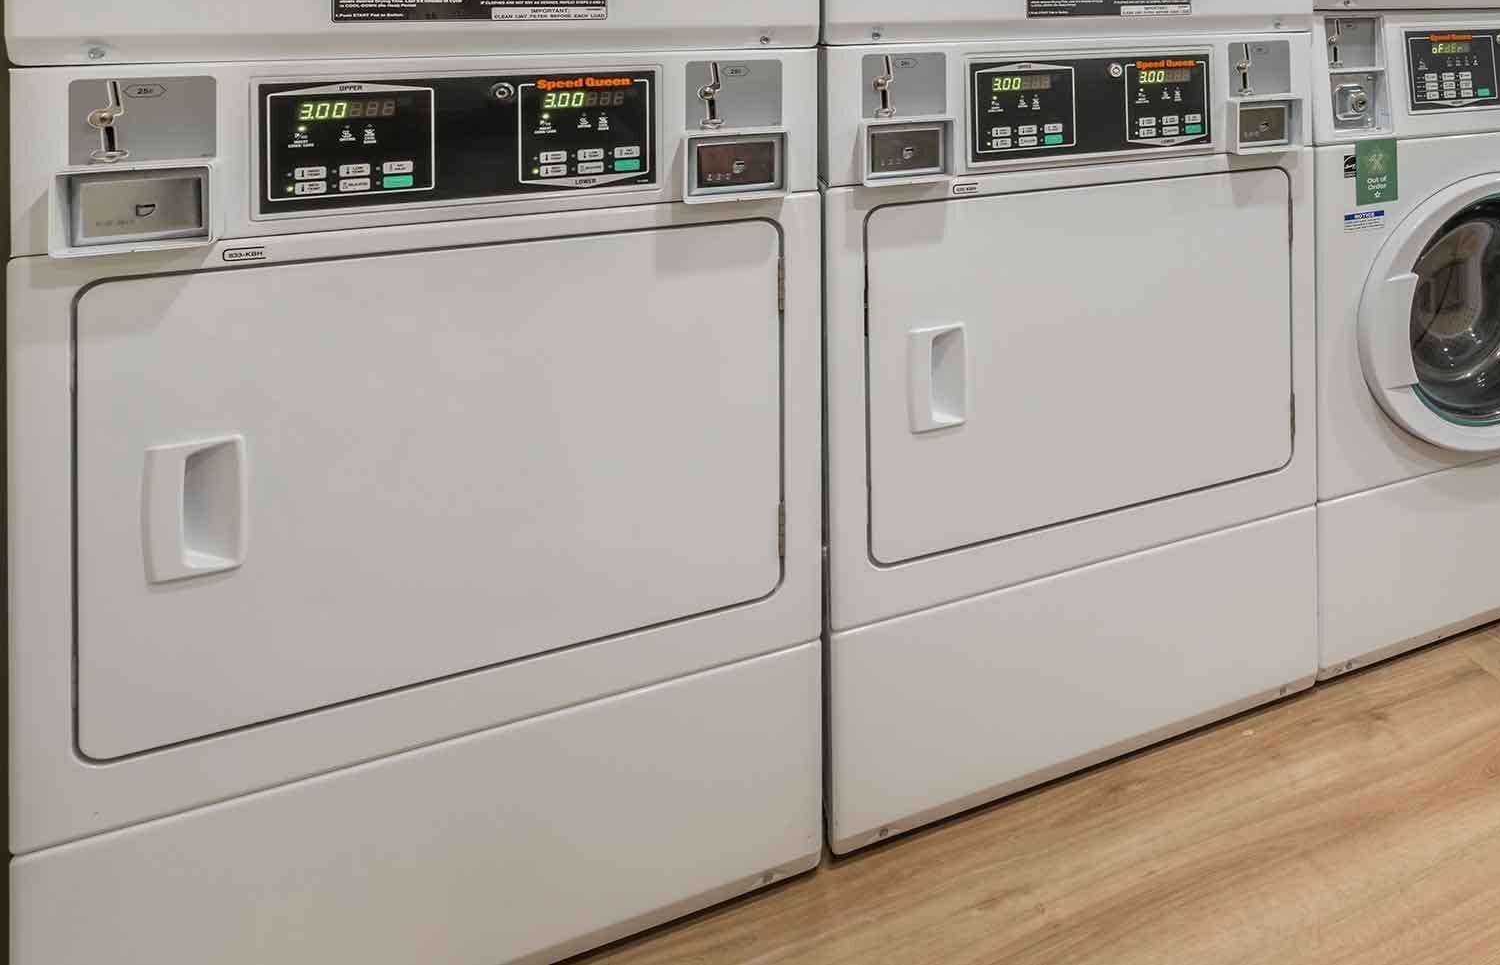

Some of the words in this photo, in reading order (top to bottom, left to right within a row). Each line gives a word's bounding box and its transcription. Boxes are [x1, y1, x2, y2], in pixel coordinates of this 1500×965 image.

[1136, 60, 1165, 69] Speed
[1139, 70, 1165, 83] 3.00
[536, 78, 583, 90] Speed
[585, 77, 632, 86] Queen
[992, 77, 1022, 91] 3.00
[544, 92, 584, 108] 3.00
[299, 102, 347, 120] 3.00
